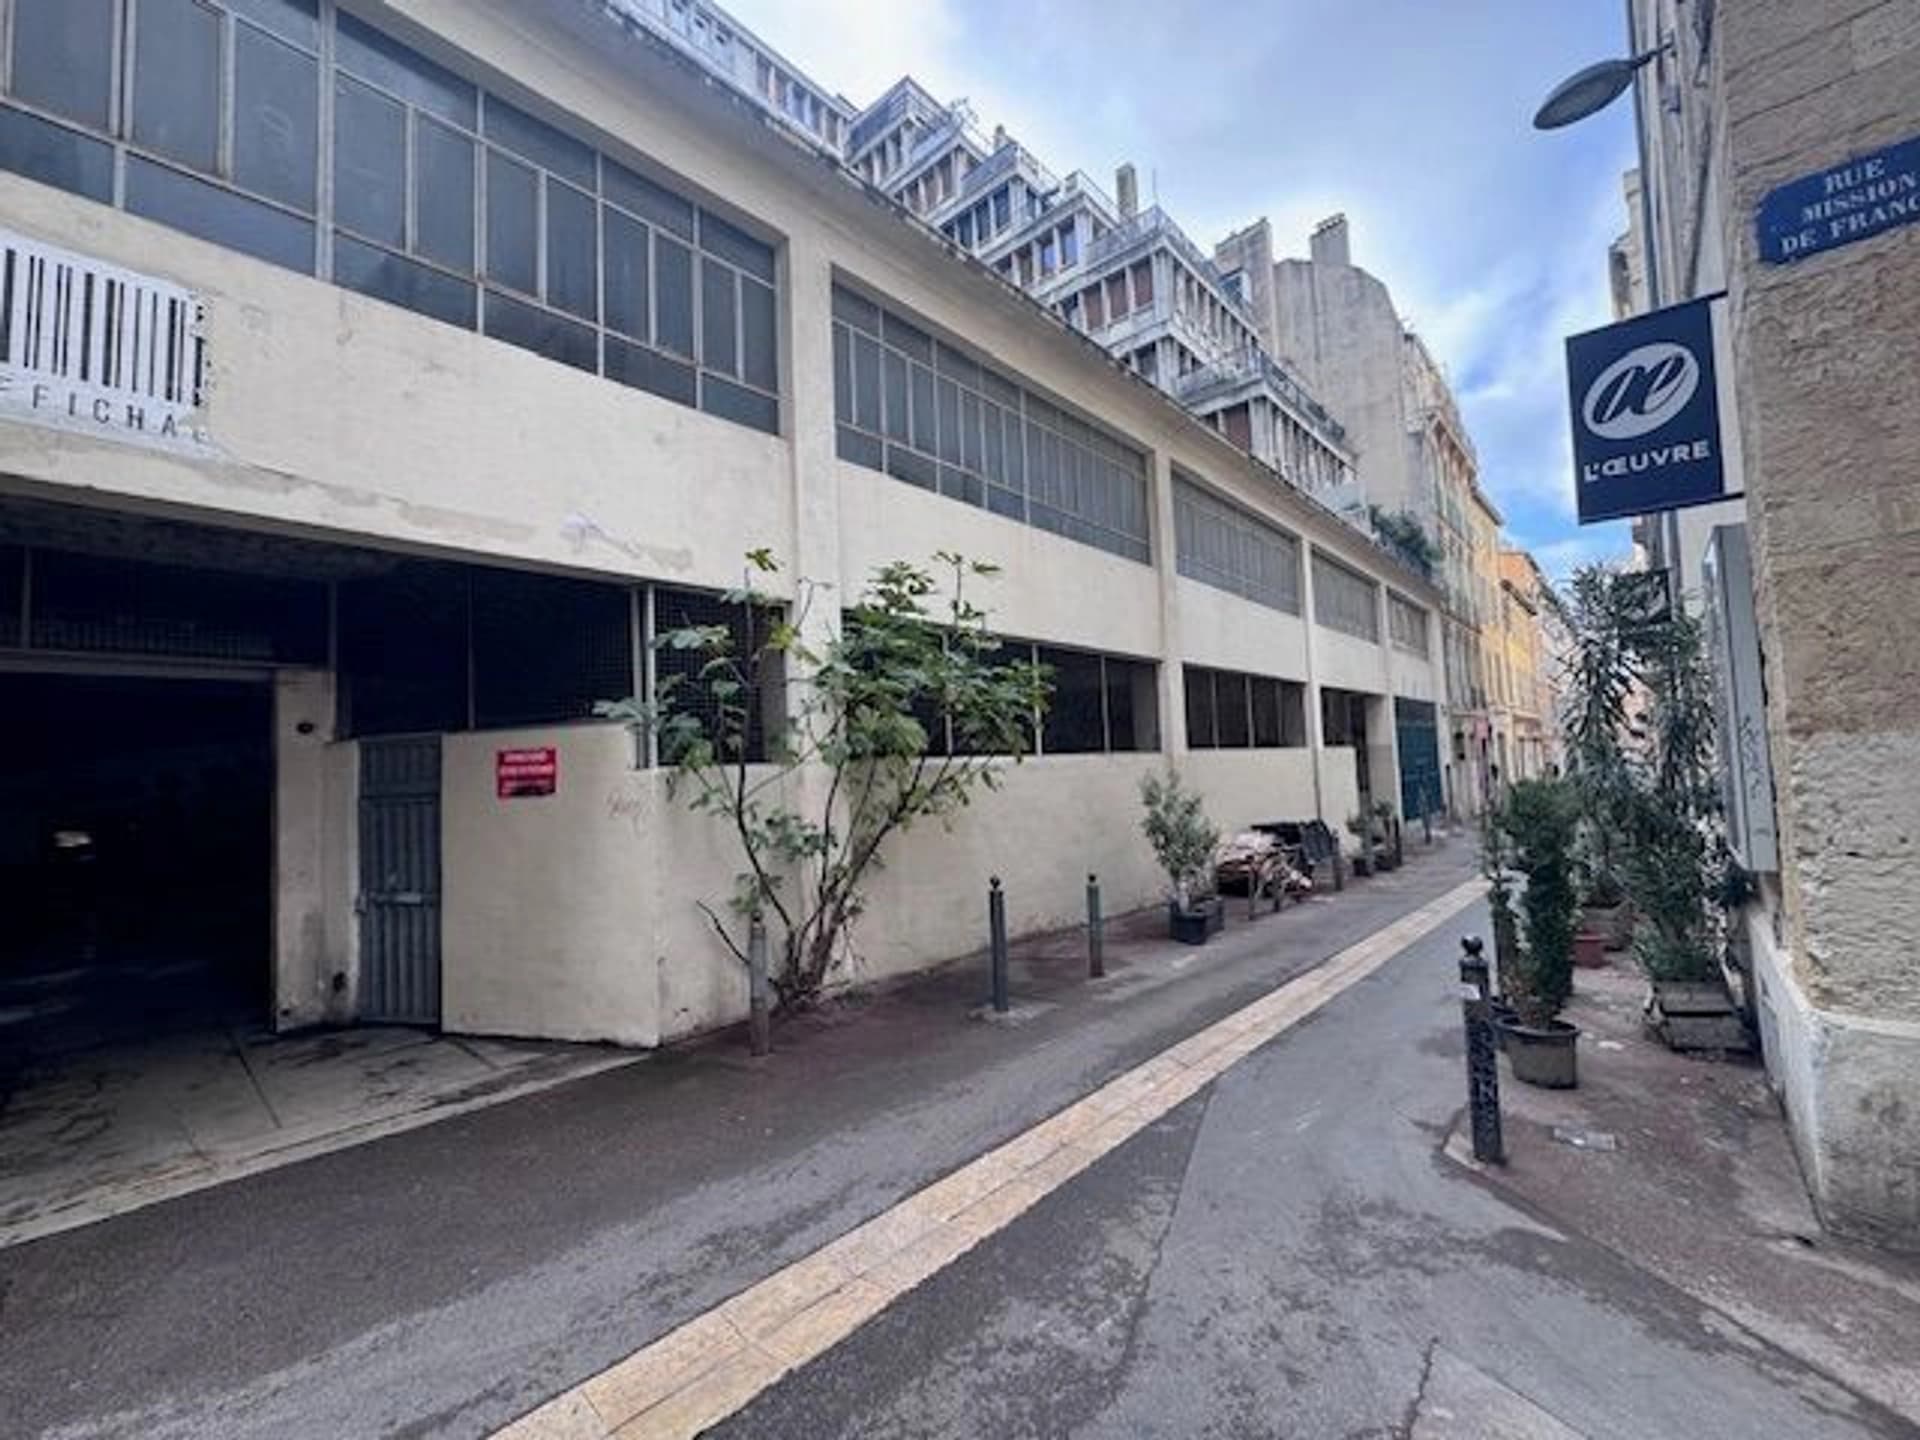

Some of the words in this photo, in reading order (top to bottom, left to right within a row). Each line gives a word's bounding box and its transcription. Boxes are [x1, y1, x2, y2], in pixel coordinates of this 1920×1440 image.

[1825, 159, 1885, 194] RUE
[1802, 171, 1916, 222] MISSION
[1782, 228, 1817, 253] DE
[1583, 440, 1710, 483] L'ŒUVRE
